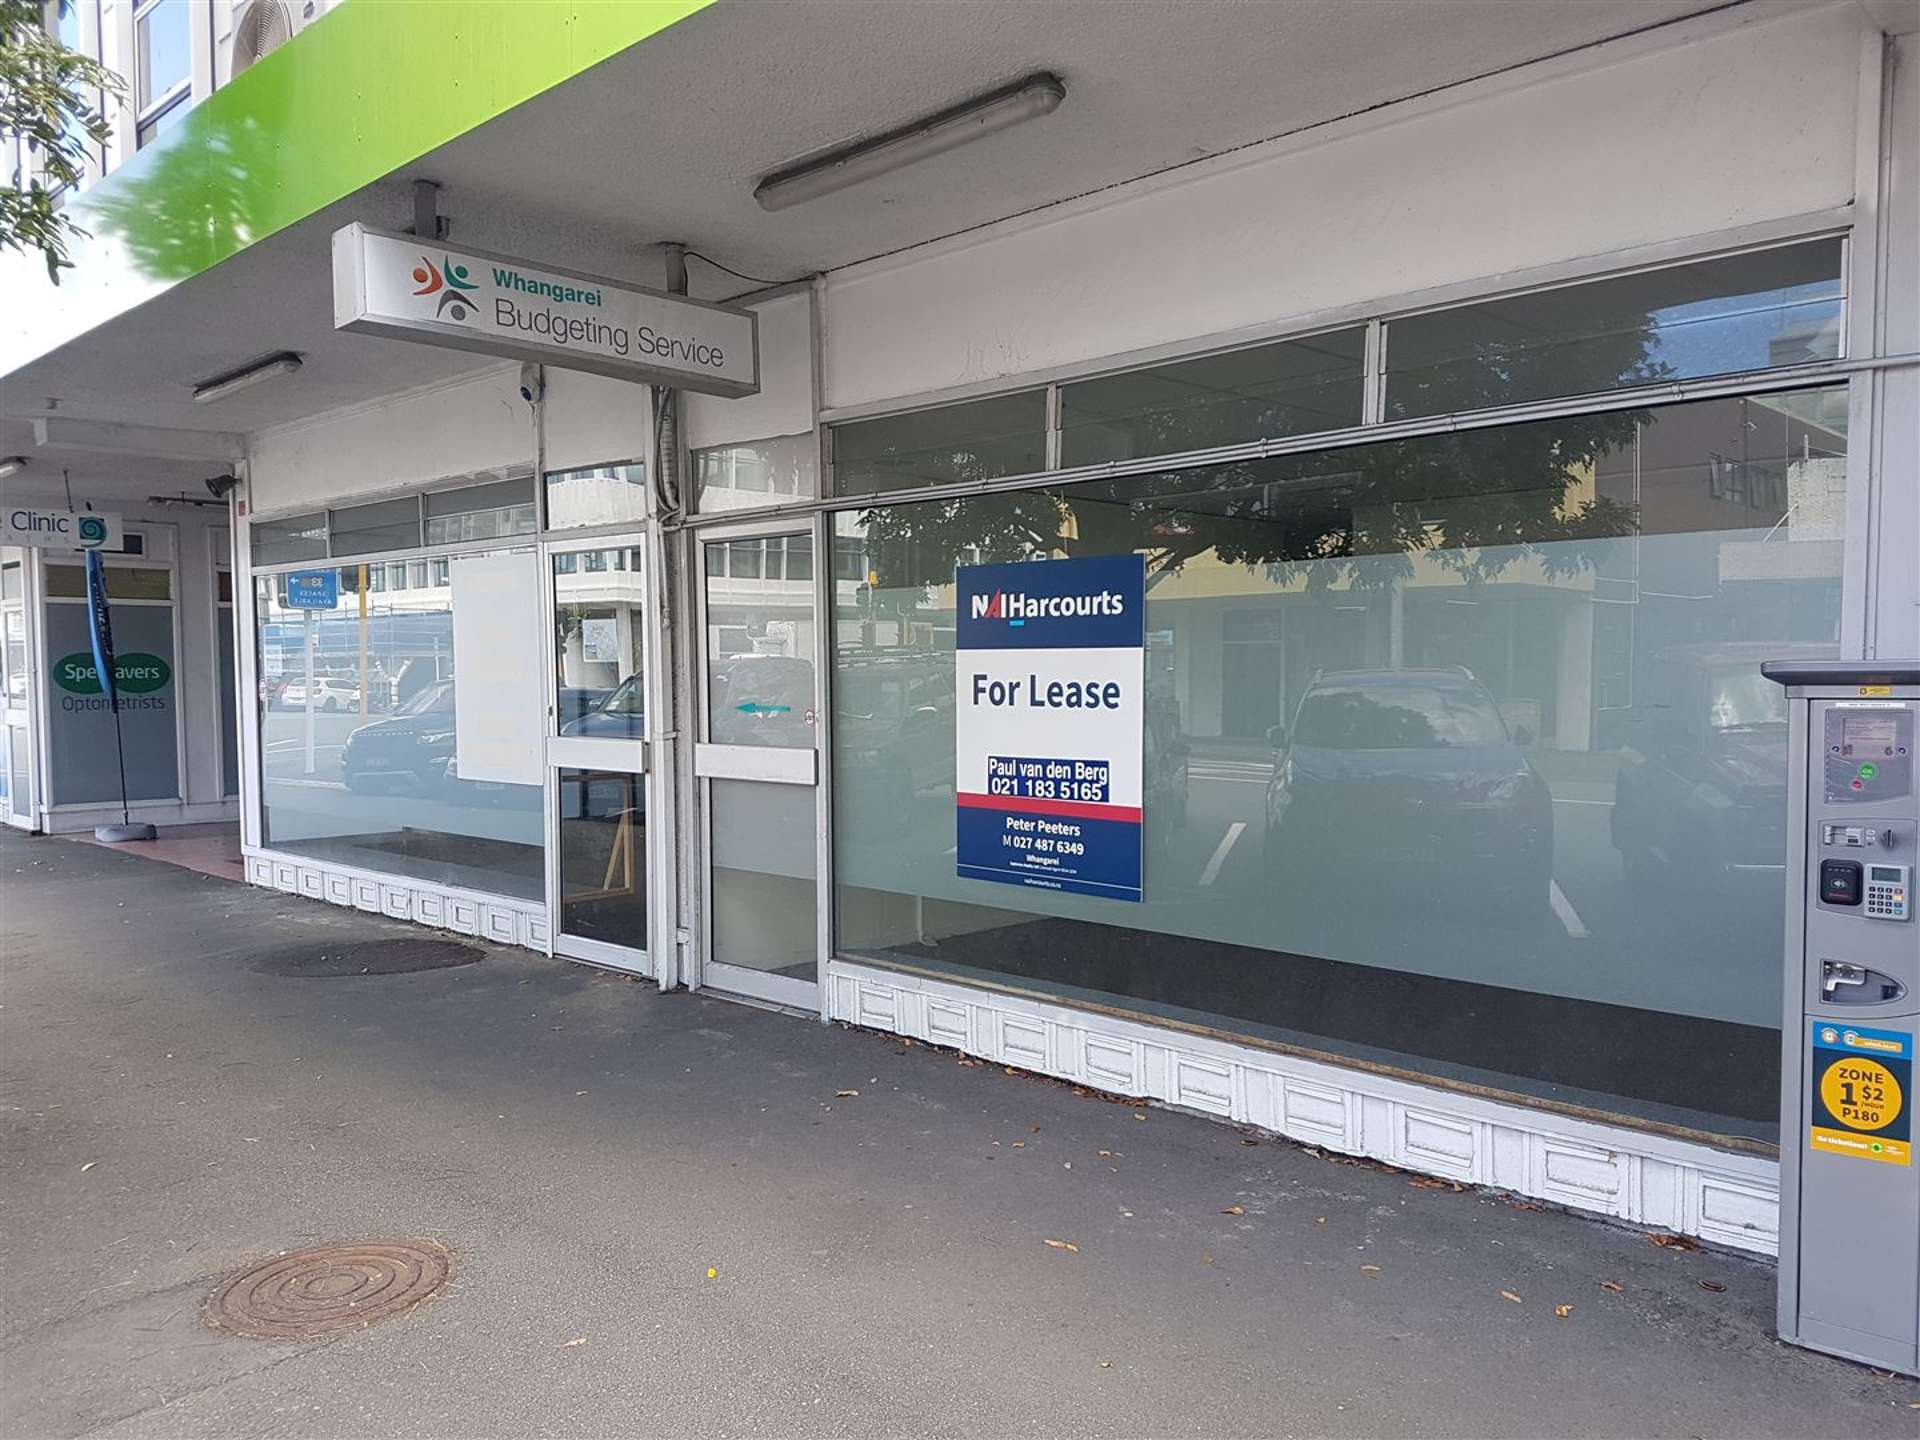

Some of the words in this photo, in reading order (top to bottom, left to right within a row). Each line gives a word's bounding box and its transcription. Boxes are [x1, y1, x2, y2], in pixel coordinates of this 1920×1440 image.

[492, 267, 602, 307] Whangarei
[495, 299, 629, 355] Budgeting
[638, 326, 724, 368] Service
[11, 511, 69, 533] Clinic
[64, 663, 160, 685] Speavers
[973, 674, 1020, 706] For
[1030, 674, 1121, 709] Lease
[989, 757, 1016, 777] Paul
[1019, 764, 1043, 779] van
[1047, 762, 1071, 780] den
[1076, 762, 1108, 785] Berg
[991, 779, 1019, 795] 021
[1026, 780, 1055, 798] 183
[1061, 782, 1102, 800] 5165
[1006, 817, 1035, 831] Peter
[1038, 820, 1081, 836] Peeters
[1002, 835, 1012, 847] M
[1013, 837, 1033, 849] 027
[1035, 839, 1055, 852] 487
[1057, 842, 1085, 856] 6349
[1026, 854, 1060, 865] Whangarei
[1839, 1068, 1884, 1084] ZONE
[1840, 1082, 1857, 1106] 1
[1862, 1086, 1884, 1101] $2
[1842, 1107, 1880, 1123] P180
